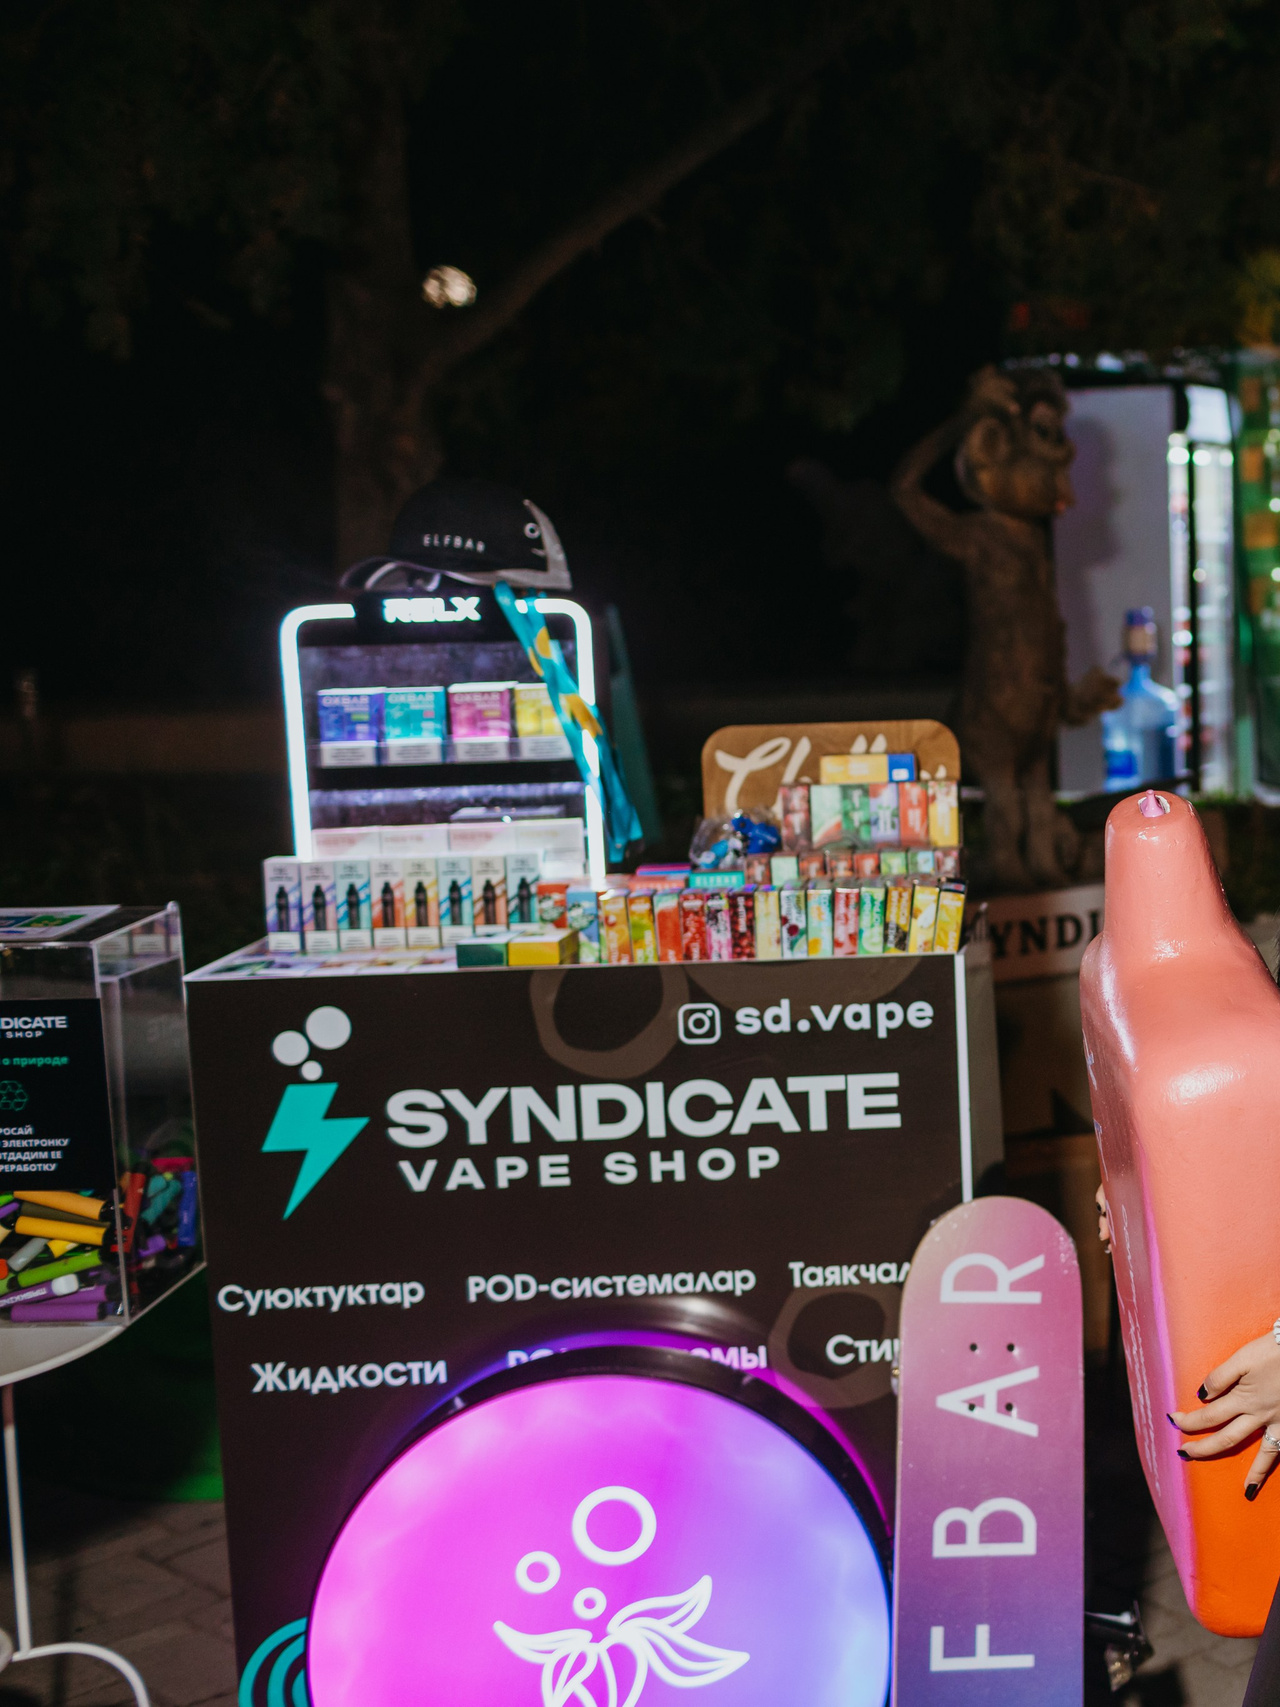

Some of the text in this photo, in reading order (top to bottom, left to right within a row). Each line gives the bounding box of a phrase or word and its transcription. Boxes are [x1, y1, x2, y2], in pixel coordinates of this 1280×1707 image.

[423, 533, 485, 553] ELFBAR
[0, 1016, 68, 1030] DICATE
[735, 998, 934, 1038] sd.vape
[5, 1031, 43, 1039] SHOP
[12, 1056, 69, 1068] природе
[386, 1072, 902, 1149] SYNDICATE
[2, 1139, 69, 1148] ЭЛЕКТРОНКУ
[50, 1151, 62, 1159] ЕЕ
[398, 1146, 780, 1192] VAPE SHOP
[217, 1281, 425, 1316] Суюктуктар
[467, 1269, 757, 1303] POD-системалар
[251, 1360, 448, 1394] Жидкости
